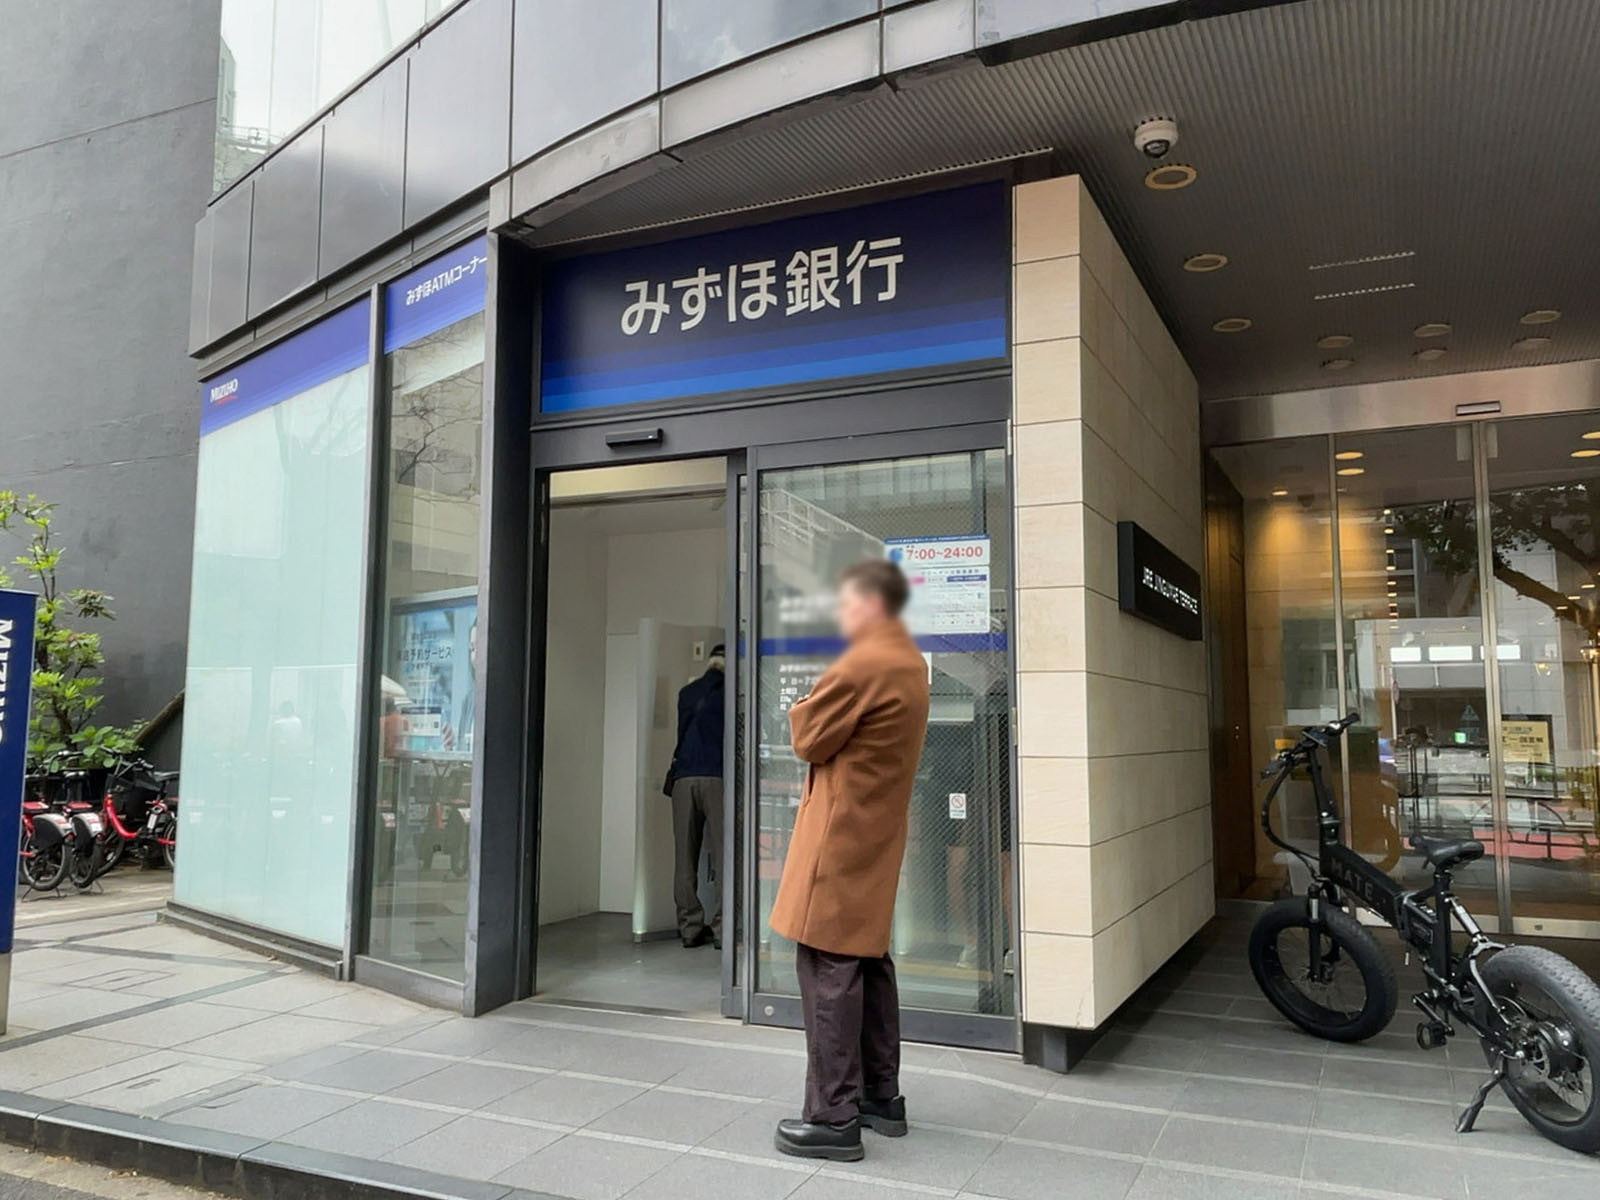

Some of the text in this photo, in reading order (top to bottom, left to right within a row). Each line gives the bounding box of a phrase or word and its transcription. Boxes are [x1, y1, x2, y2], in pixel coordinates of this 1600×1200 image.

[406, 256, 488, 305] みずほATMコーナー
[621, 237, 904, 335] みずほ銀行
